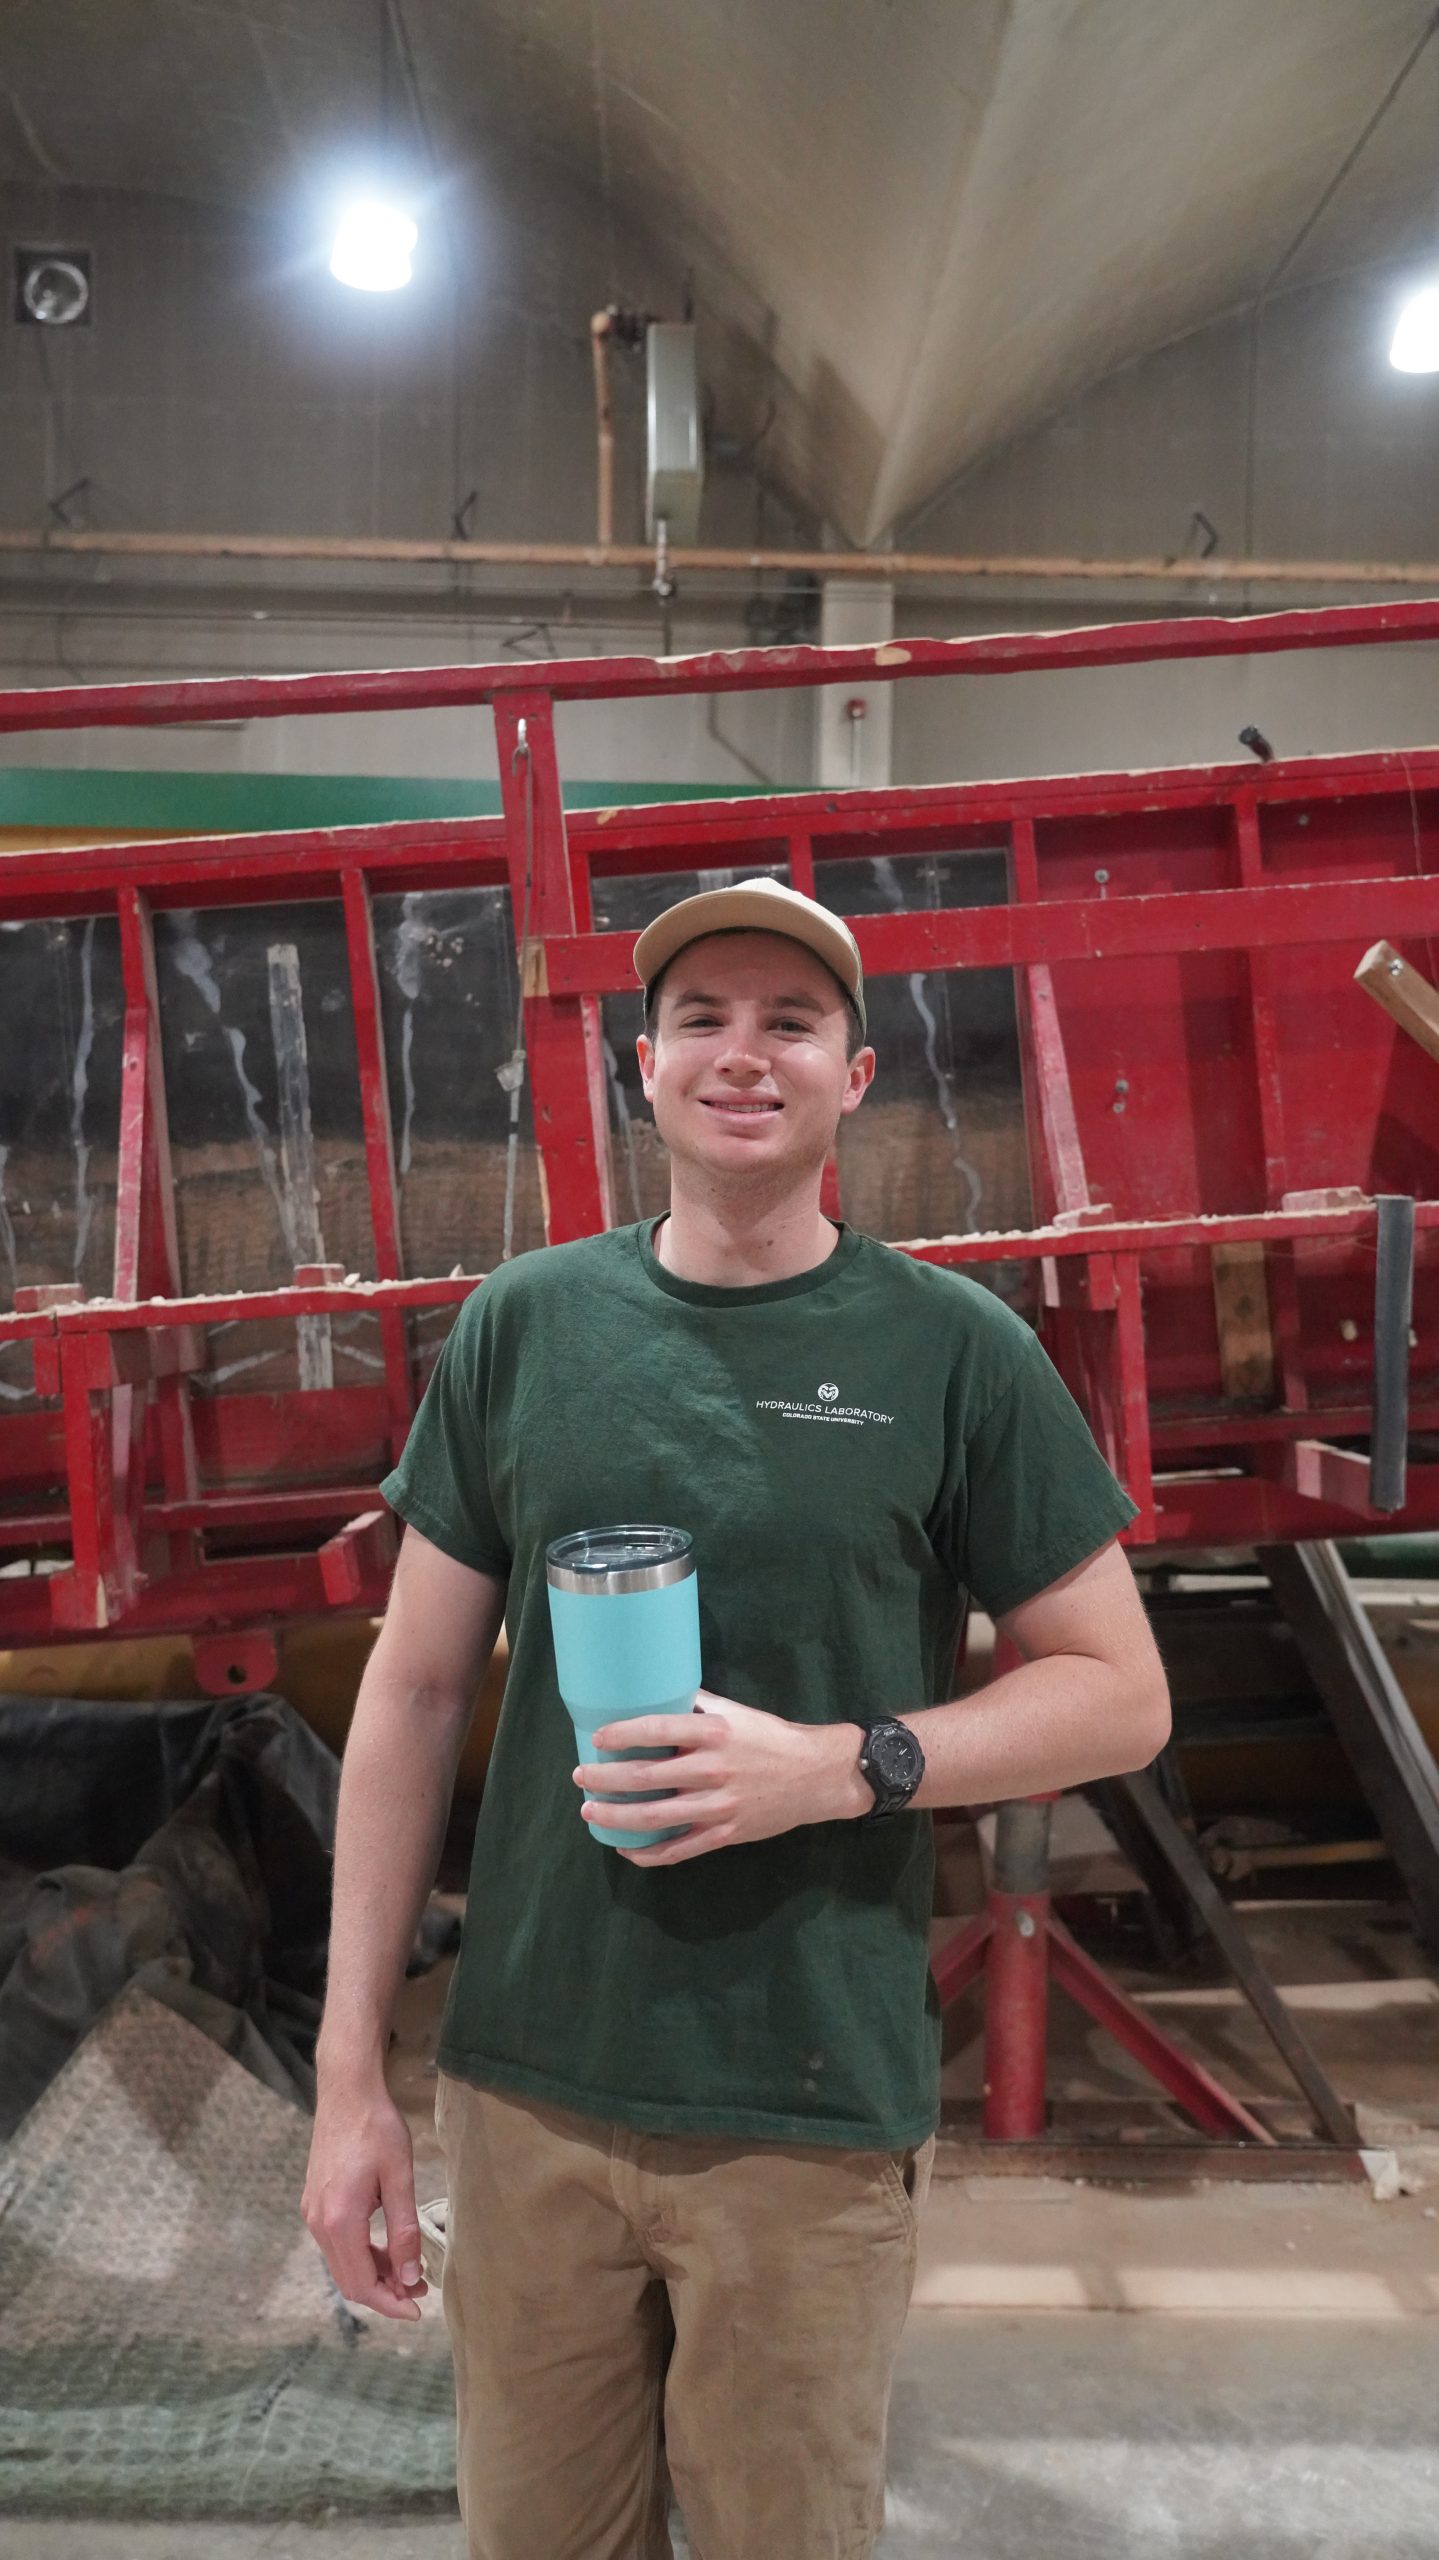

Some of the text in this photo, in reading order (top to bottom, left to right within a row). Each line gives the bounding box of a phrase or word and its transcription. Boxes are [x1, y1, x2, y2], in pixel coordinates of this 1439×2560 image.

[756, 1401, 895, 1424] HYDRAULICS LABORATORY
[782, 1412, 865, 1426] COLORADO STATE UNIVERSITY
